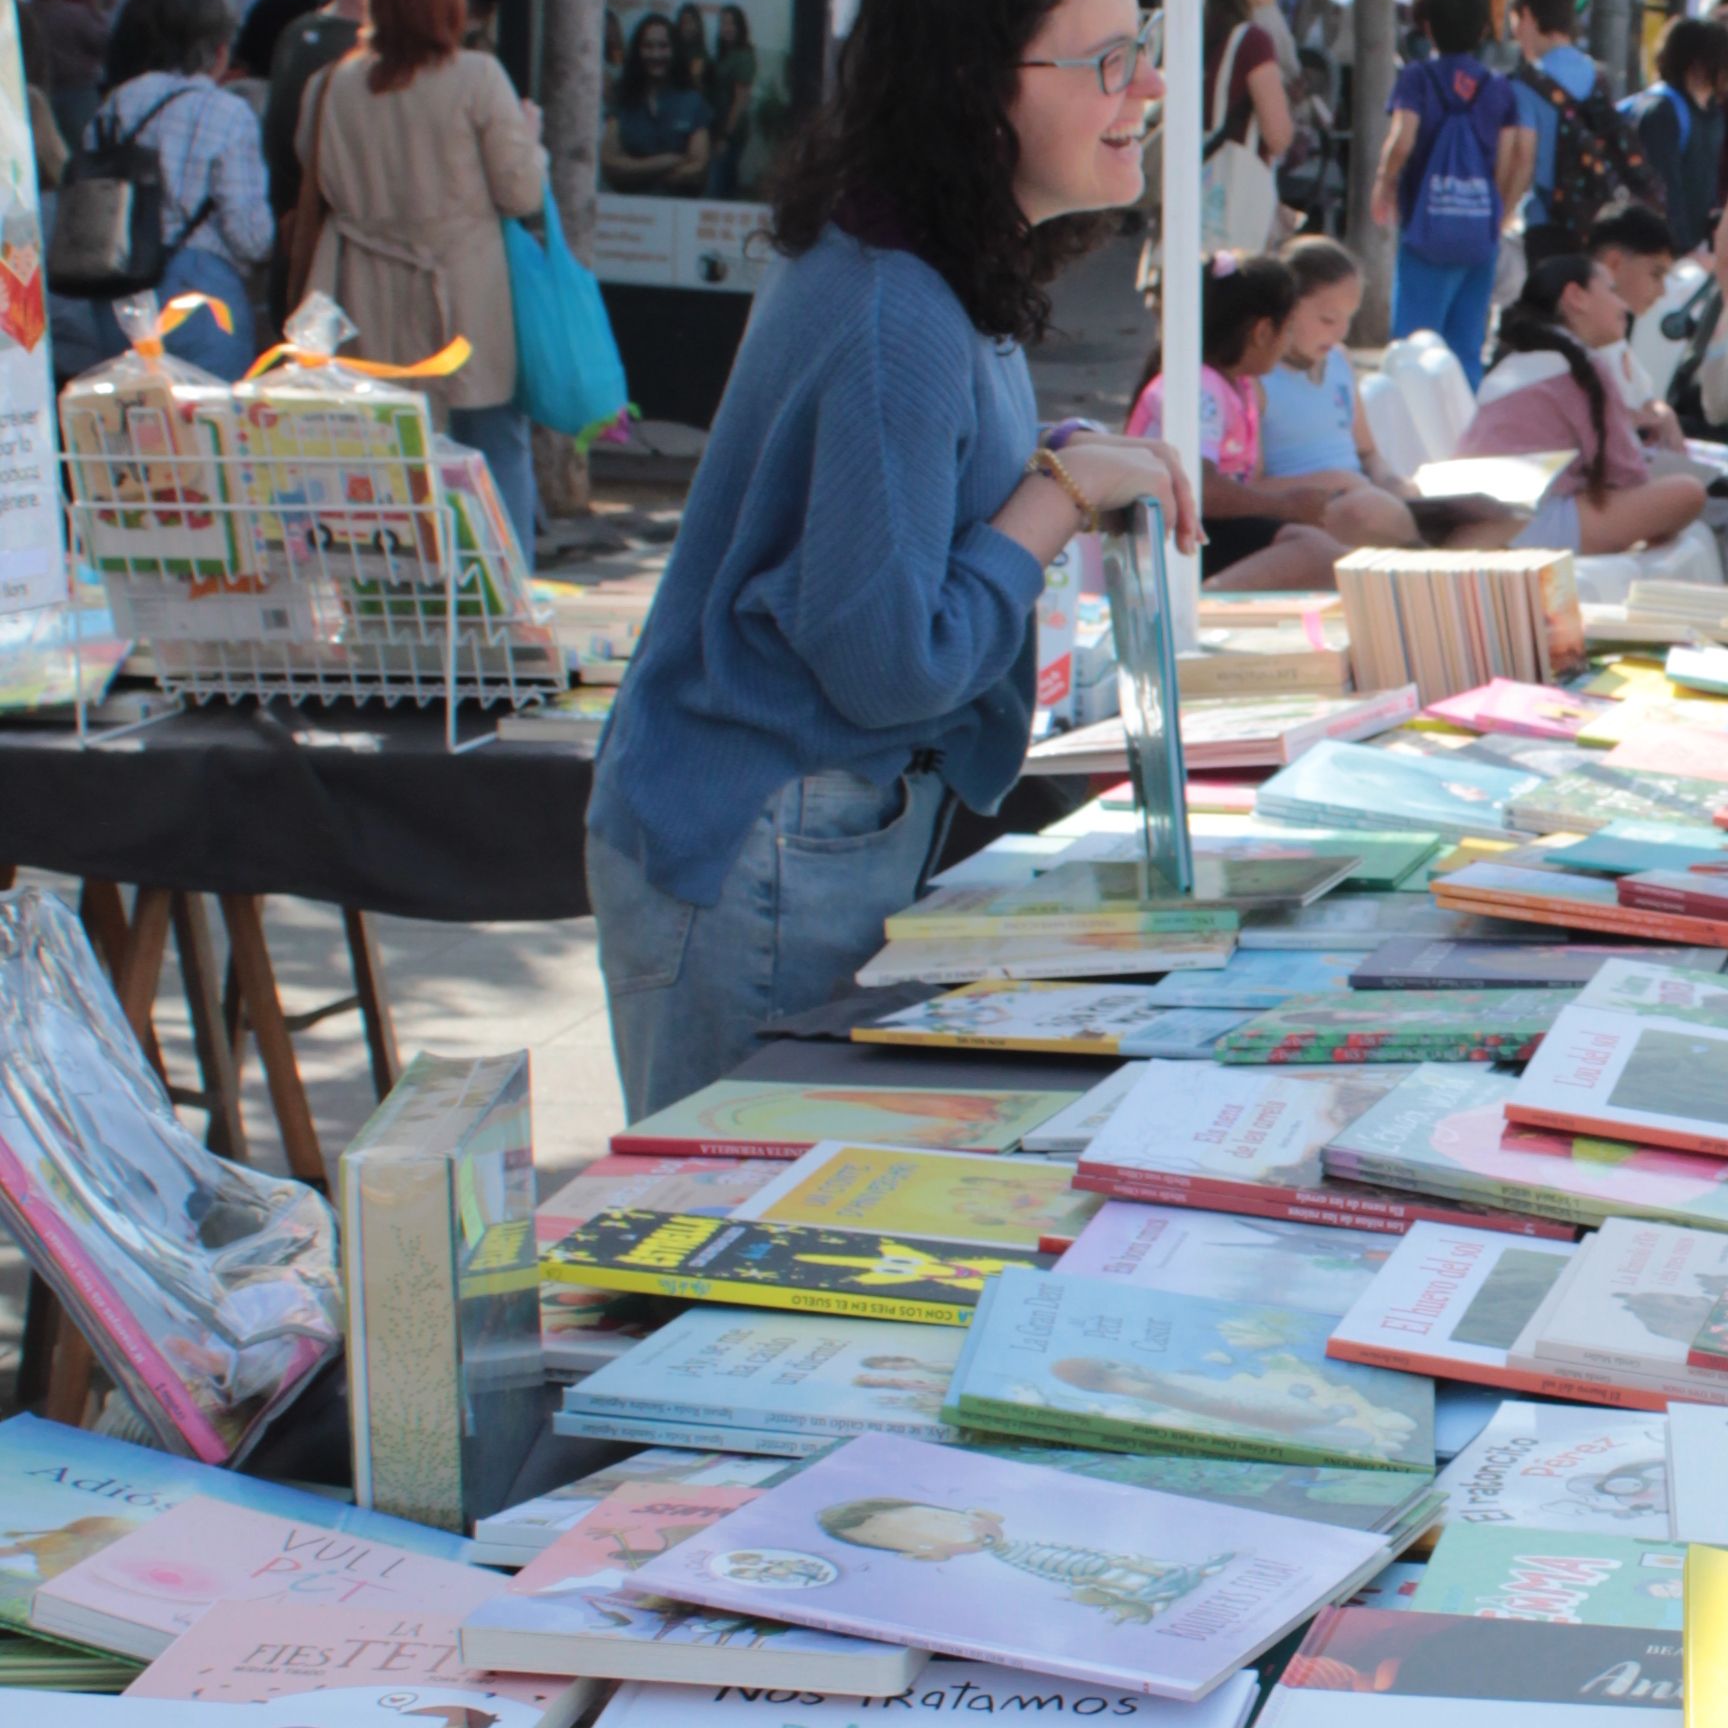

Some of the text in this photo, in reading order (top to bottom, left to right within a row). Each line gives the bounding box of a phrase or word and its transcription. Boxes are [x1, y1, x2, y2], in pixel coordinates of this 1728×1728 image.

[613, 1215, 724, 1268] ESTRELLA
[1024, 1282, 1065, 1311] Dent
[1380, 1239, 1485, 1335] El huevo del sol
[791, 1294, 953, 1321] CON LOS PIES EN EL SUELO
[1016, 1312, 1056, 1337] Gran
[1131, 1317, 1173, 1353] Castor
[1458, 1437, 1540, 1524] El ratoncito
[282, 1528, 406, 1579] VULL
[388, 1619, 425, 1638] LA
[241, 1639, 474, 1676] FIESTET
